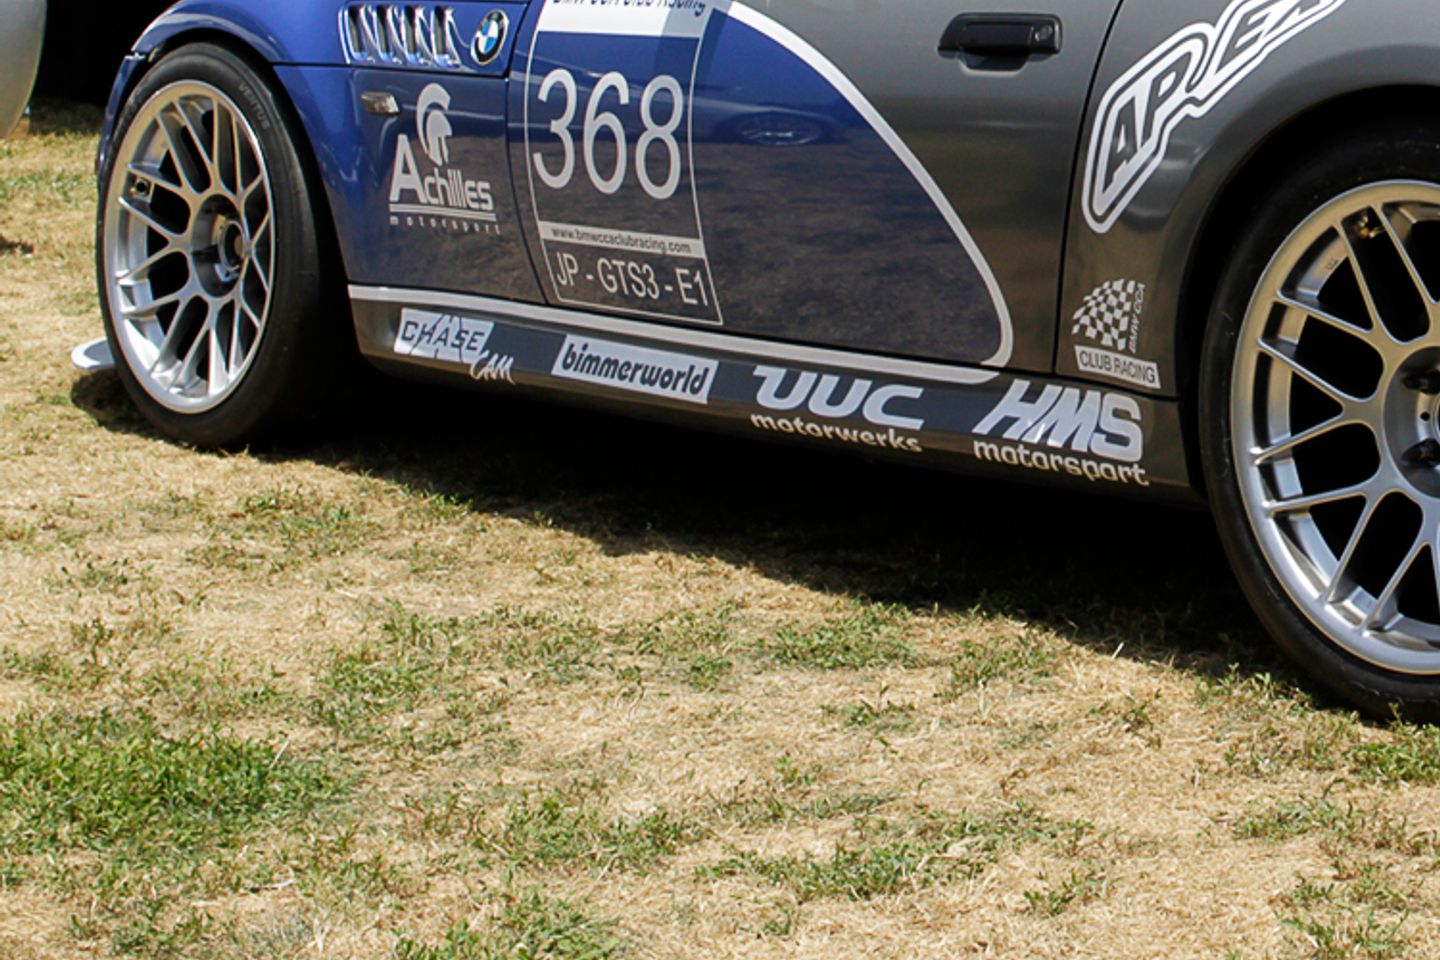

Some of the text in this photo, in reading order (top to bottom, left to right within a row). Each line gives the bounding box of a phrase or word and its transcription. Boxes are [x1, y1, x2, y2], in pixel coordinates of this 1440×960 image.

[532, 67, 685, 200] 368
[389, 132, 495, 211] Achilles
[556, 251, 580, 288] JP
[597, 256, 661, 300] GTS3
[675, 267, 709, 307] E1
[401, 320, 485, 351] CHASE
[562, 343, 709, 396] bimmerworld
[1079, 349, 1157, 384] CLUB RACING
[752, 364, 926, 431] UUC
[971, 378, 1144, 463] HMS
[750, 411, 923, 454] motorwerks
[973, 438, 1150, 487] motorsport
